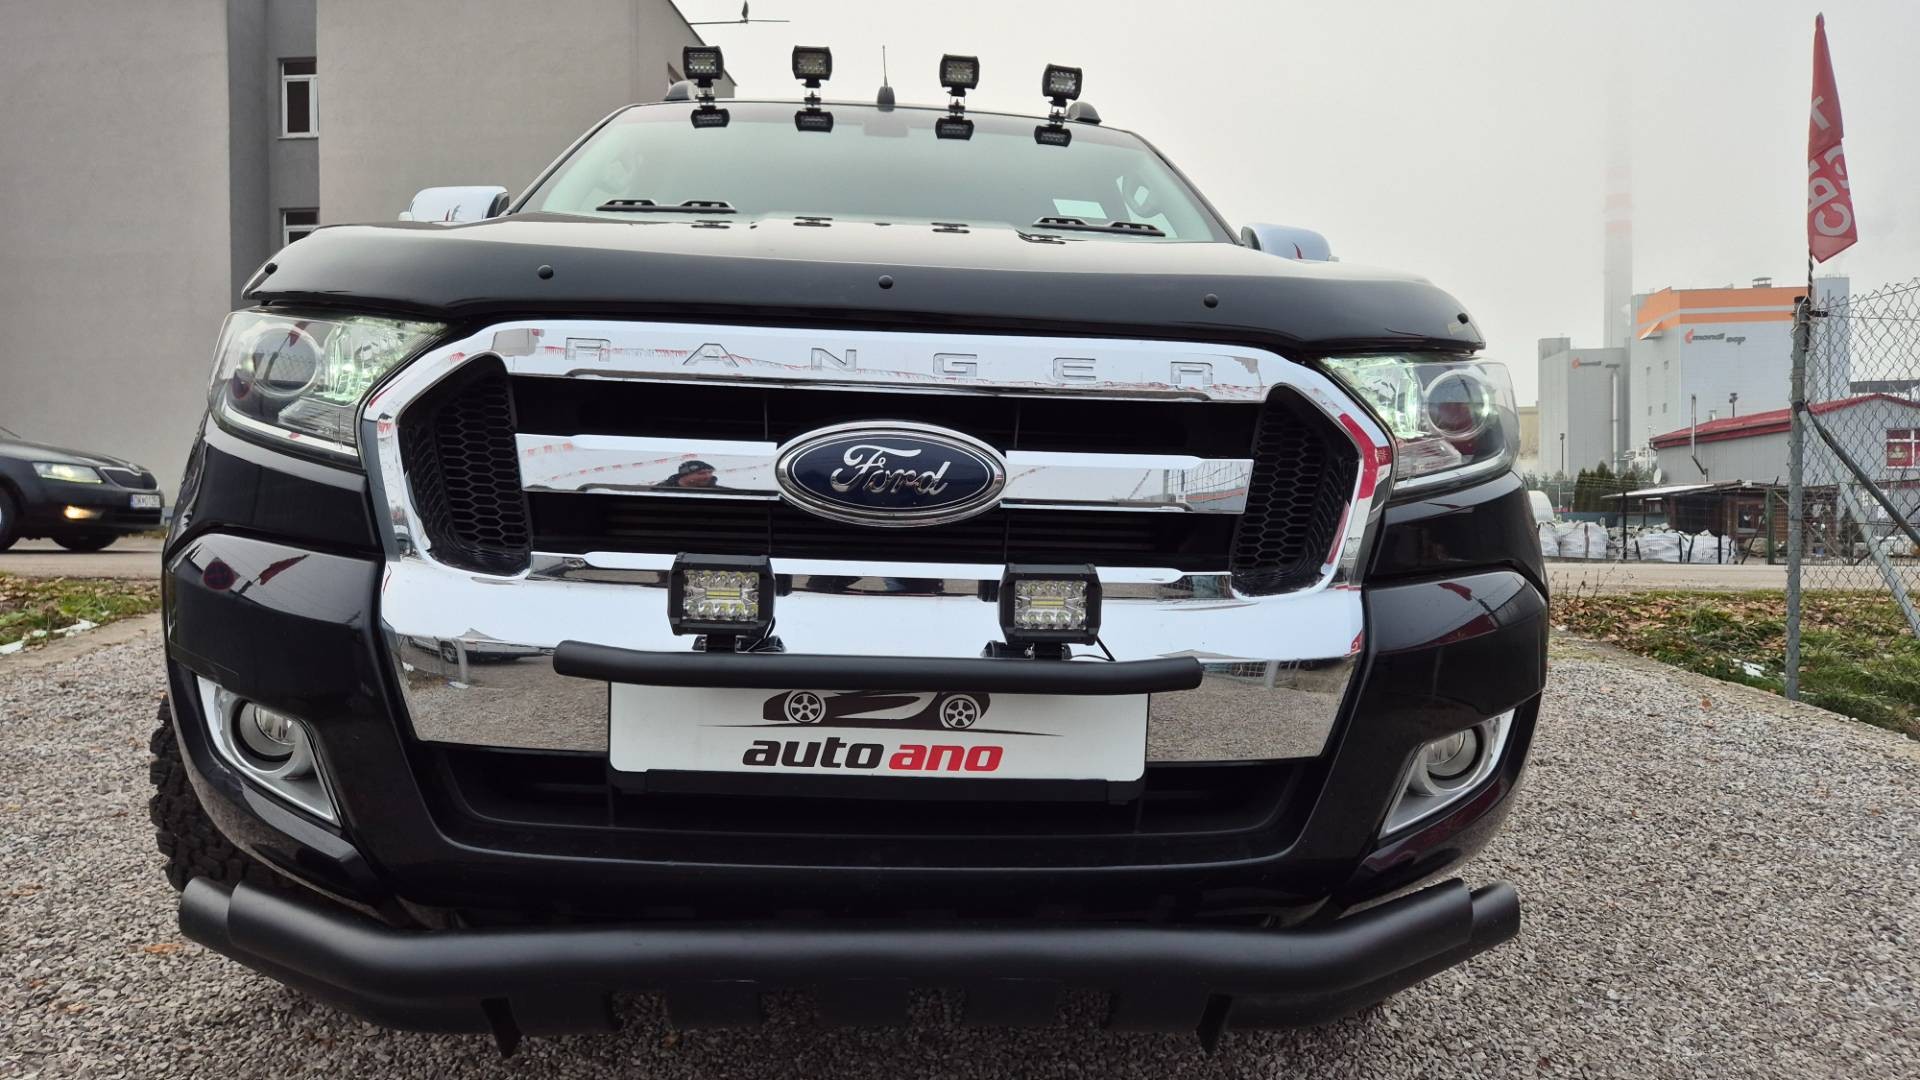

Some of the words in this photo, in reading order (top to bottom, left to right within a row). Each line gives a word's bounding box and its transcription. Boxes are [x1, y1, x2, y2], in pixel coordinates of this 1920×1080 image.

[565, 337, 1213, 386] RANGER
[829, 443, 951, 496] Ford
[742, 736, 885, 769] auto
[888, 743, 1005, 772] ano
